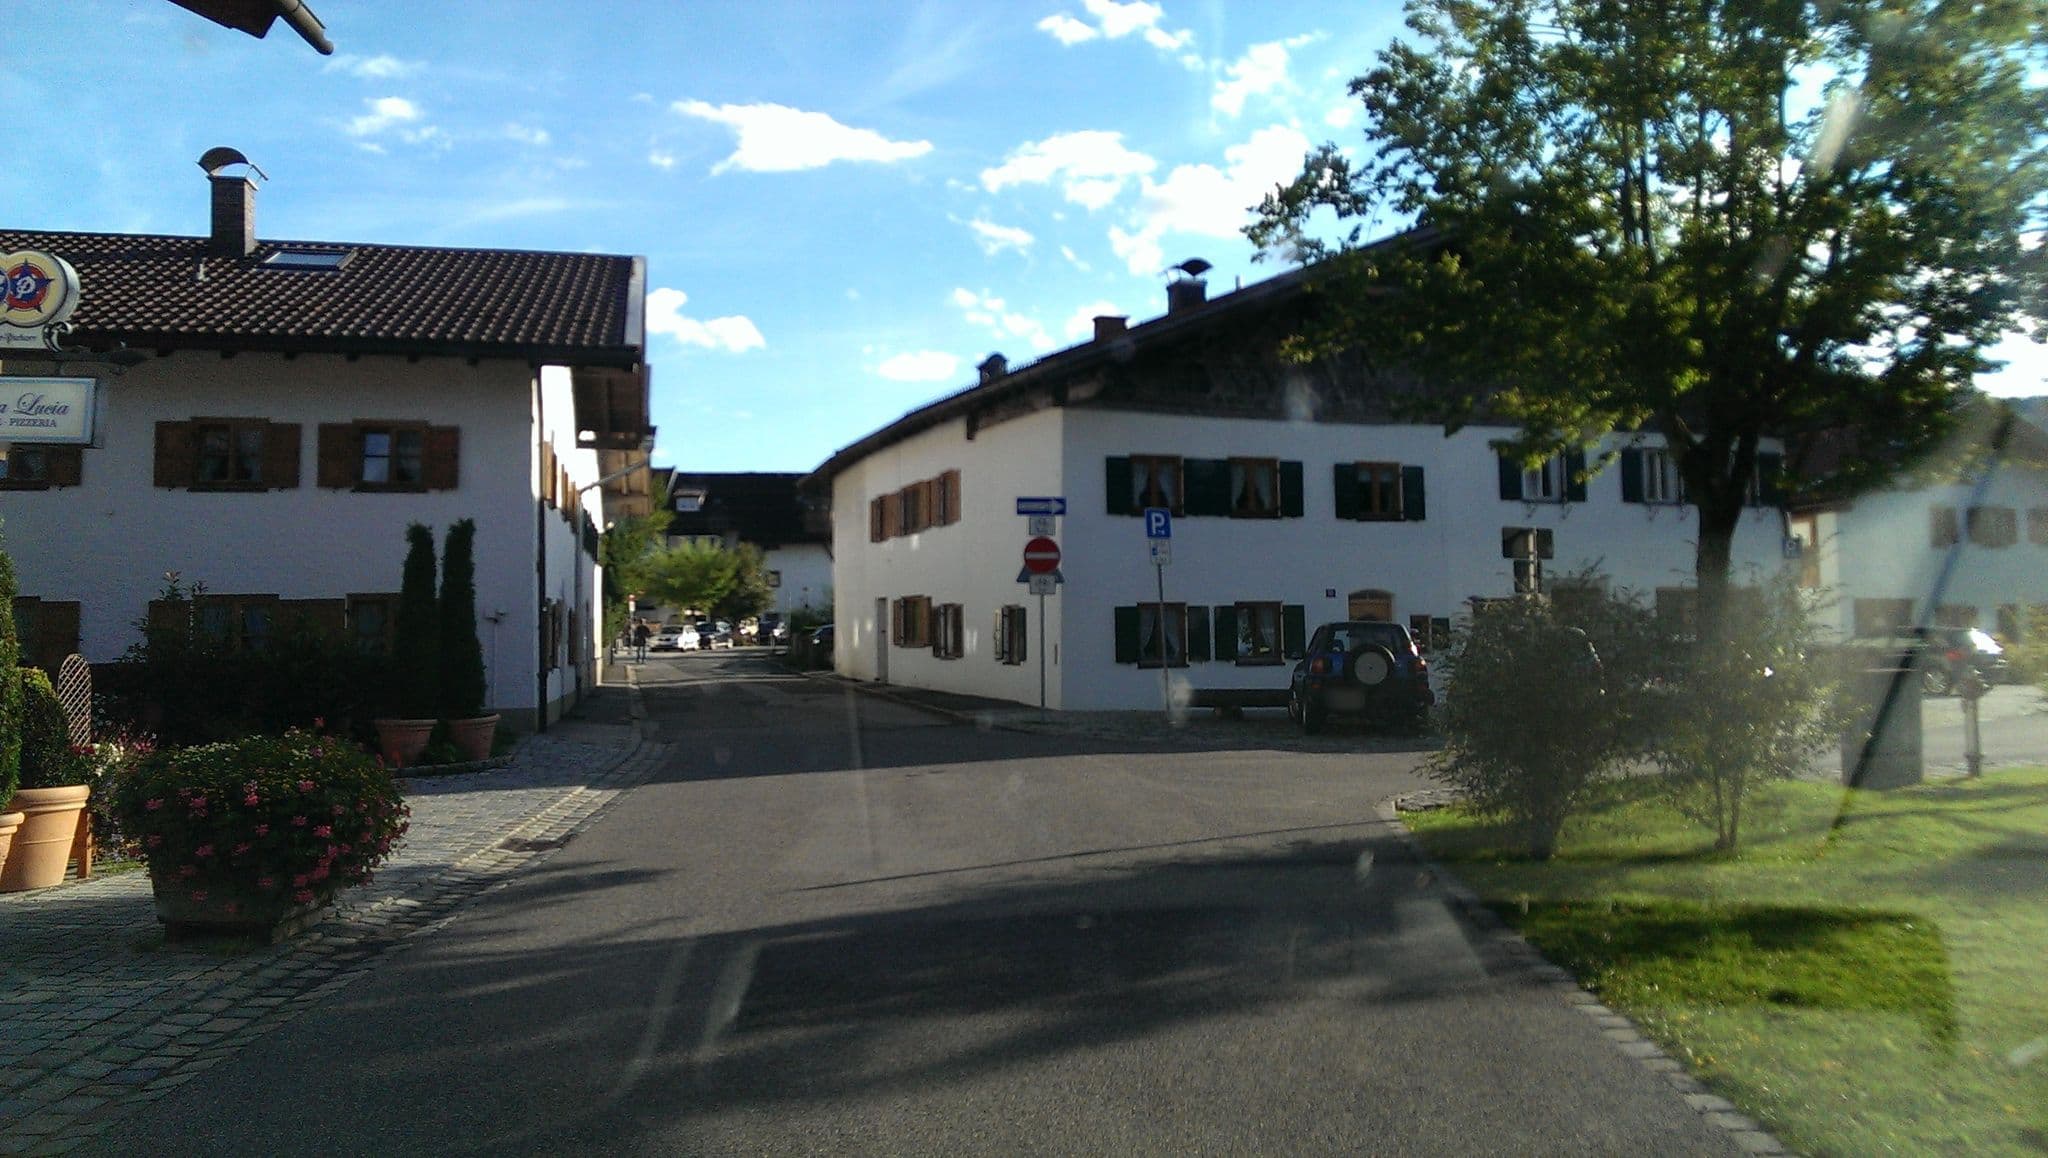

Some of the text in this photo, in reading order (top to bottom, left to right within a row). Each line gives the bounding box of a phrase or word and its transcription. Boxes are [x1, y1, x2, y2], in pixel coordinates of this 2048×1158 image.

[13, 392, 70, 416] Lucia
[9, 417, 57, 428] PIZZERIA
[1151, 512, 1165, 536] P
